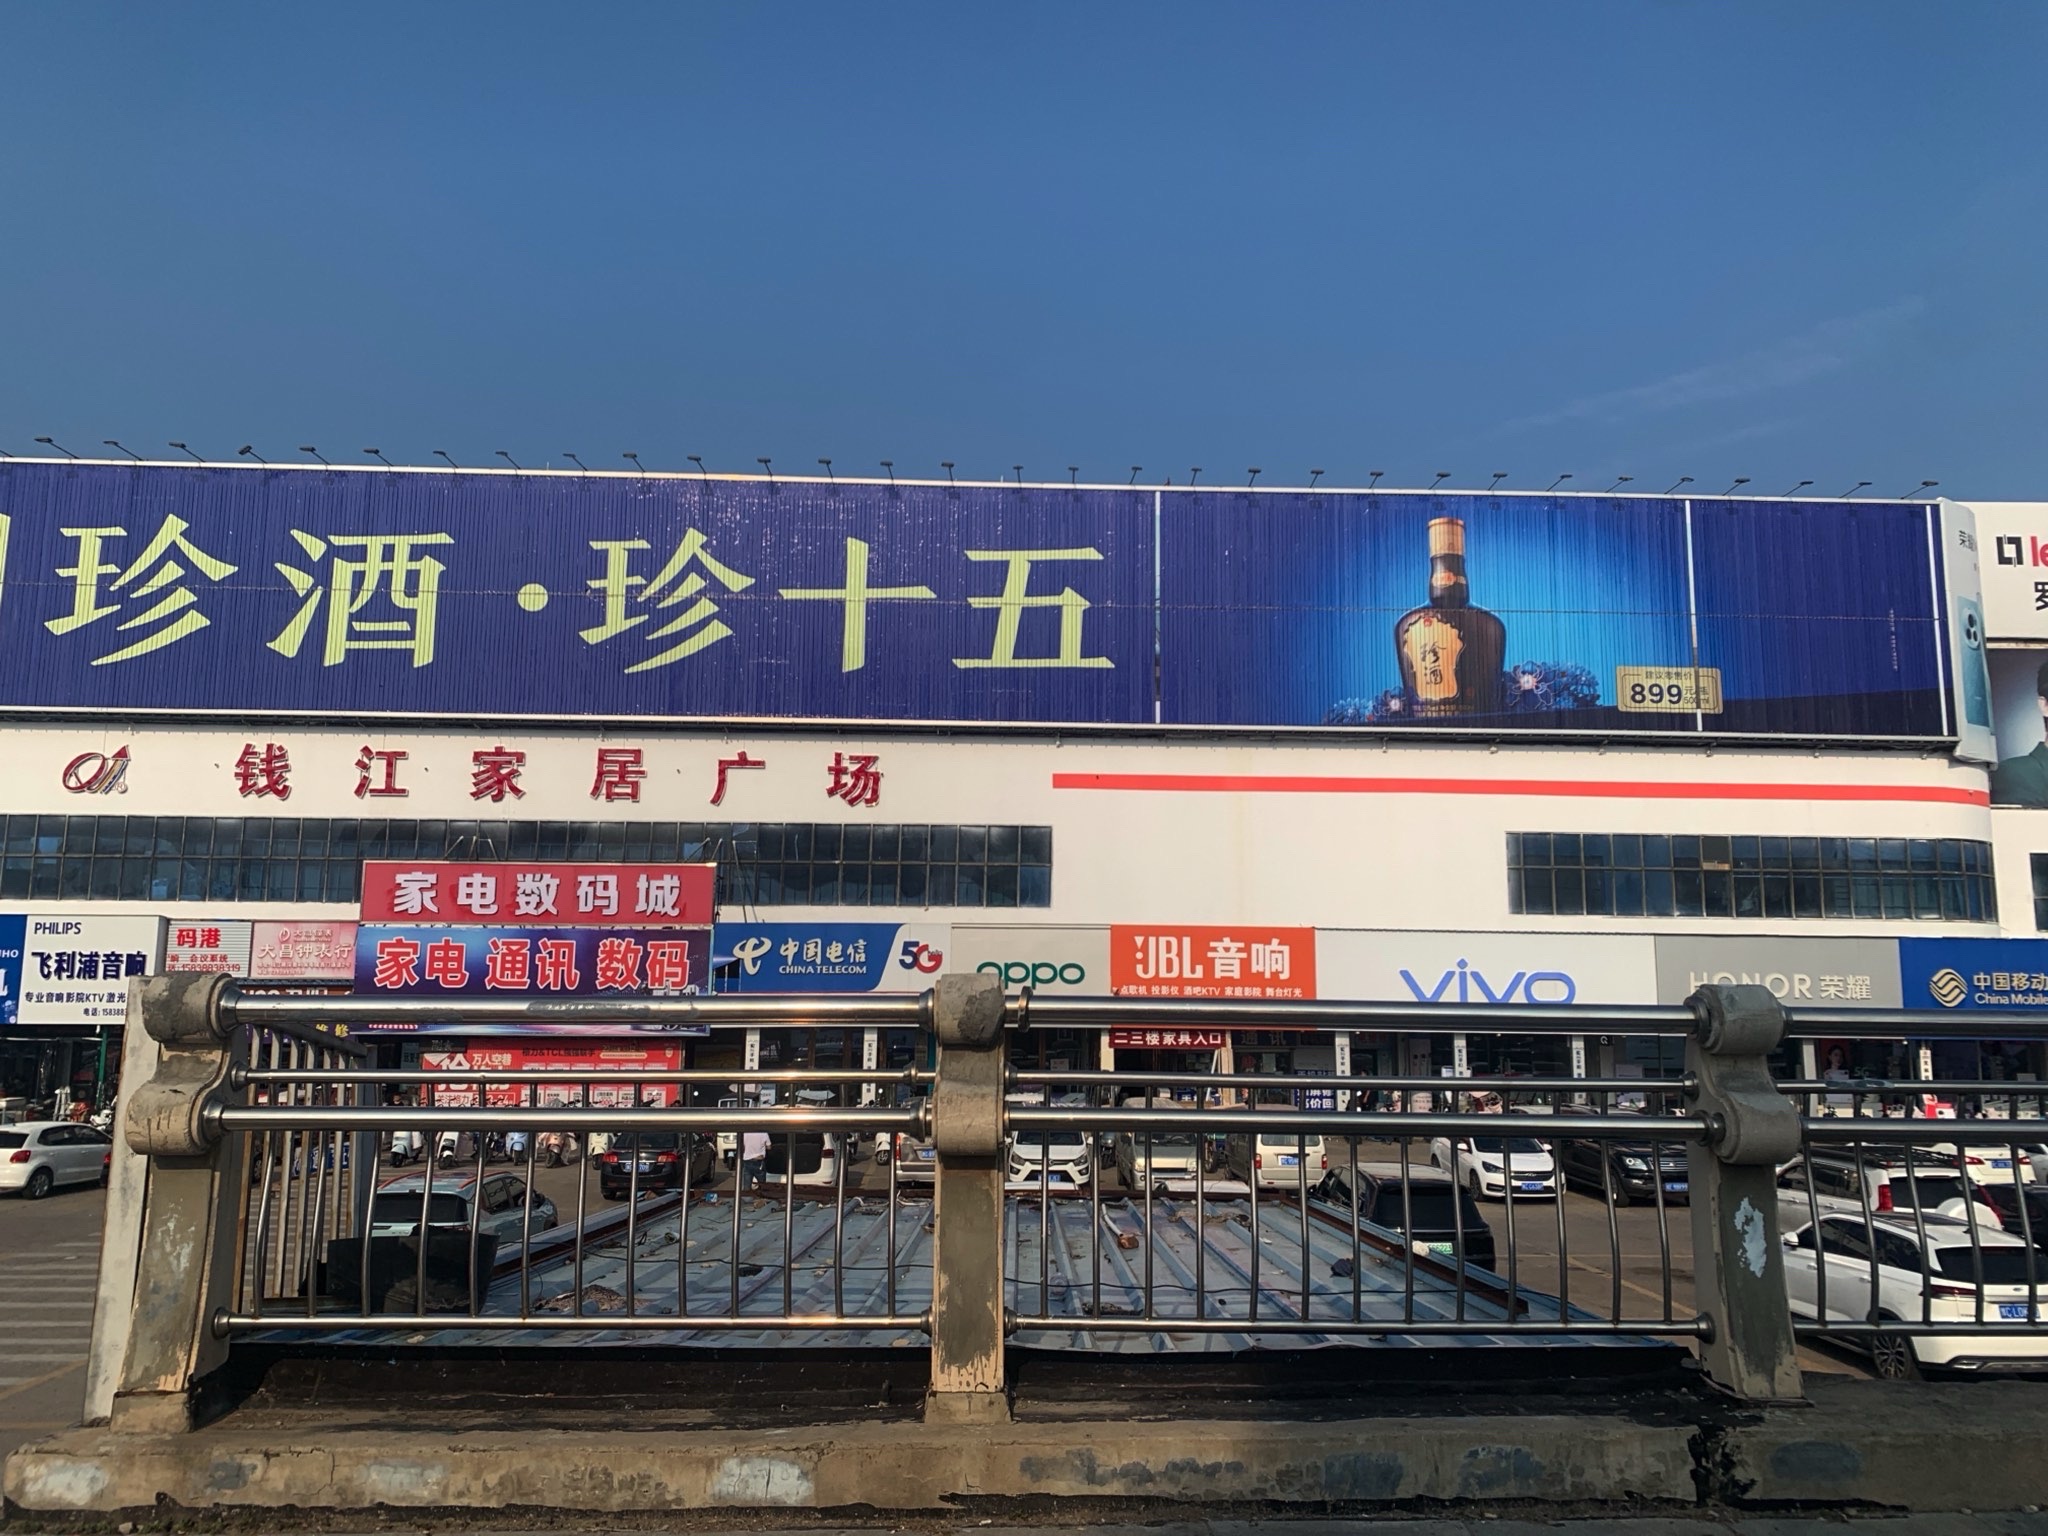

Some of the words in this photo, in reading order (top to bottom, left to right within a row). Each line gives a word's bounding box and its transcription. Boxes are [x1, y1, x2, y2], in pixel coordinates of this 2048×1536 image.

[44, 513, 1115, 673] 珍酒·珍十五
[1645, 670, 1692, 680] 建议零售价
[1630, 683, 1682, 704] 899
[234, 742, 883, 807] 钱江家居广场
[393, 871, 681, 916] 家电数码城
[34, 922, 82, 934] PHILIPS
[176, 927, 222, 948] 码港
[257, 943, 353, 959] 大昌钟表行
[779, 937, 868, 966] 中国电信
[898, 940, 943, 974] 5G
[1134, 936, 1203, 980] JBL
[1207, 937, 1290, 981] 音响
[31, 951, 148, 980] 飞利浦音响
[375, 937, 469, 989] 家电
[485, 938, 580, 989] 通讯
[595, 938, 690, 990] 数码
[779, 965, 813, 974] CHINA
[816, 965, 867, 974] TELECOM
[1119, 985, 1147, 995] 点歌机
[1151, 985, 1179, 996] 投影仪
[1183, 986, 1220, 996] 酒吧KTV
[1224, 986, 1261, 997] 家庭影院
[1265, 986, 1303, 997] 舞台灯光
[1399, 958, 1576, 1004] vivo
[1819, 975, 1872, 1000] 荣耀
[1973, 972, 2048, 991] 中国移动
[1974, 993, 2009, 1004] China
[1114, 1031, 1222, 1046] 二三楼家具入口
